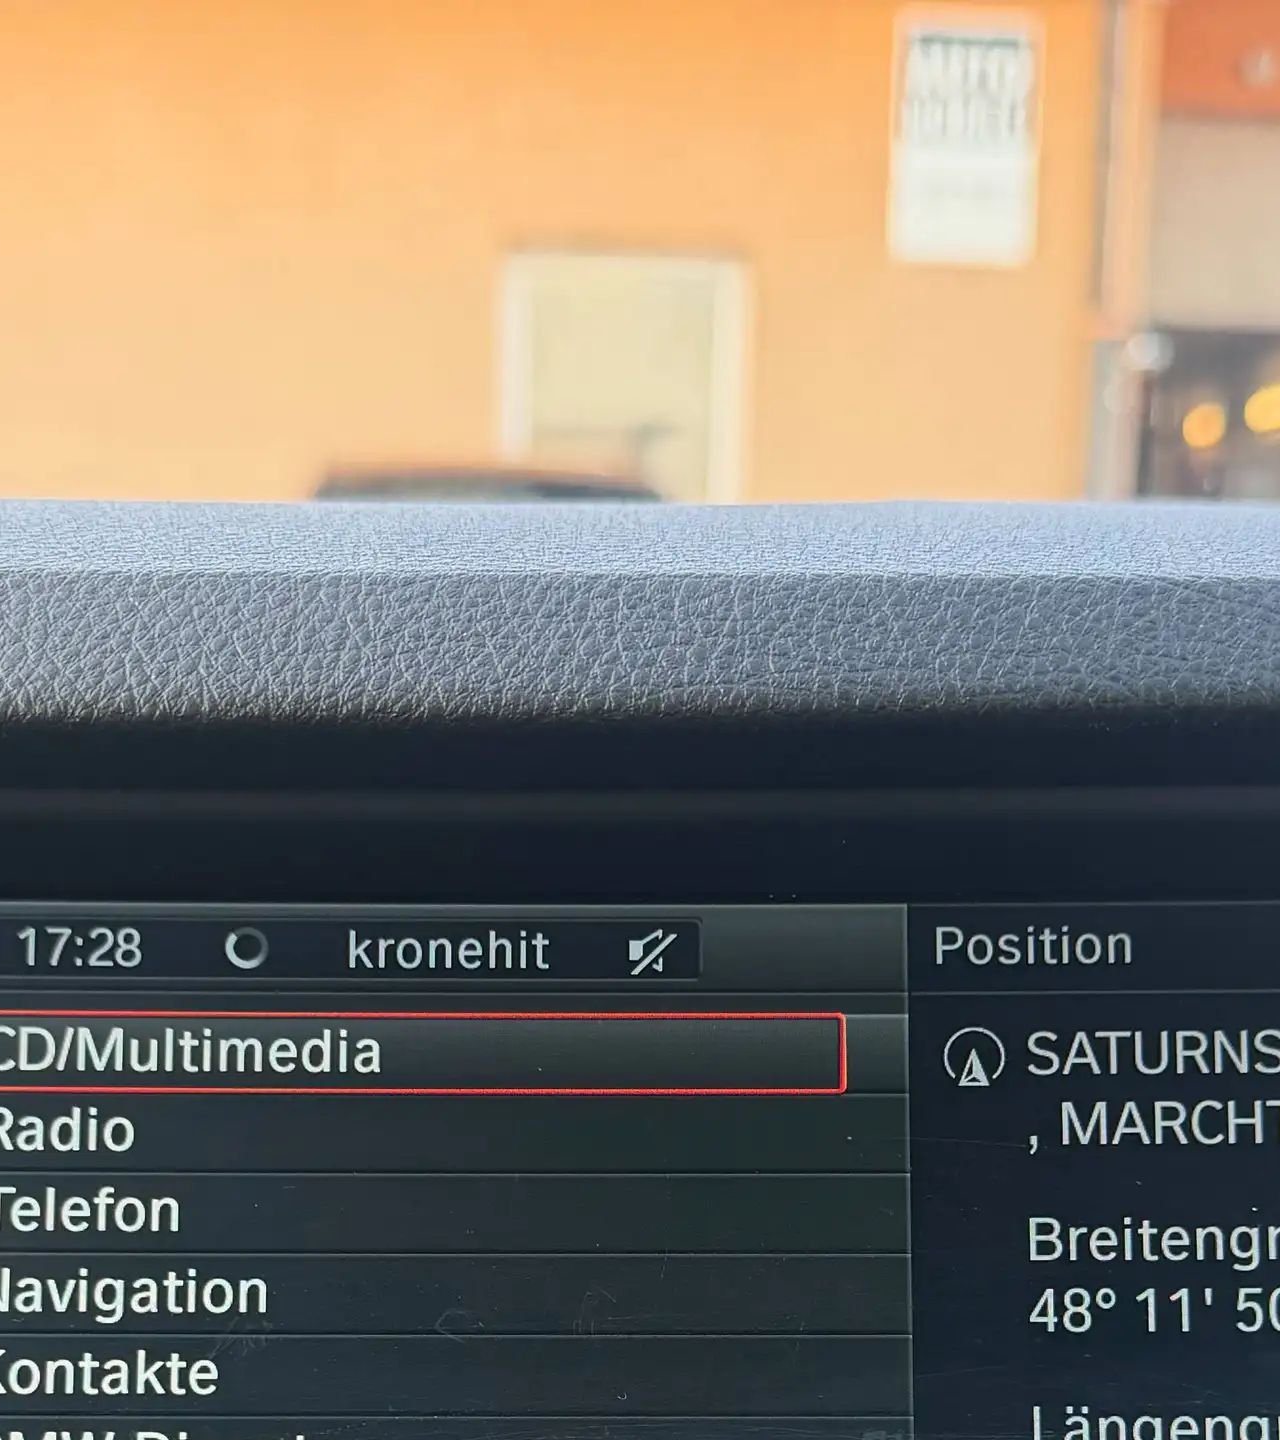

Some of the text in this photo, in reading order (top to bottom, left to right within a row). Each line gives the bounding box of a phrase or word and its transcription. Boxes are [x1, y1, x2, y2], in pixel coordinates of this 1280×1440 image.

[17, 927, 142, 968] 17:28
[348, 929, 550, 970] kronehit
[935, 925, 1132, 965] Position
[1029, 1287, 1116, 1333] 48°
[1135, 1287, 1213, 1333] 11'
